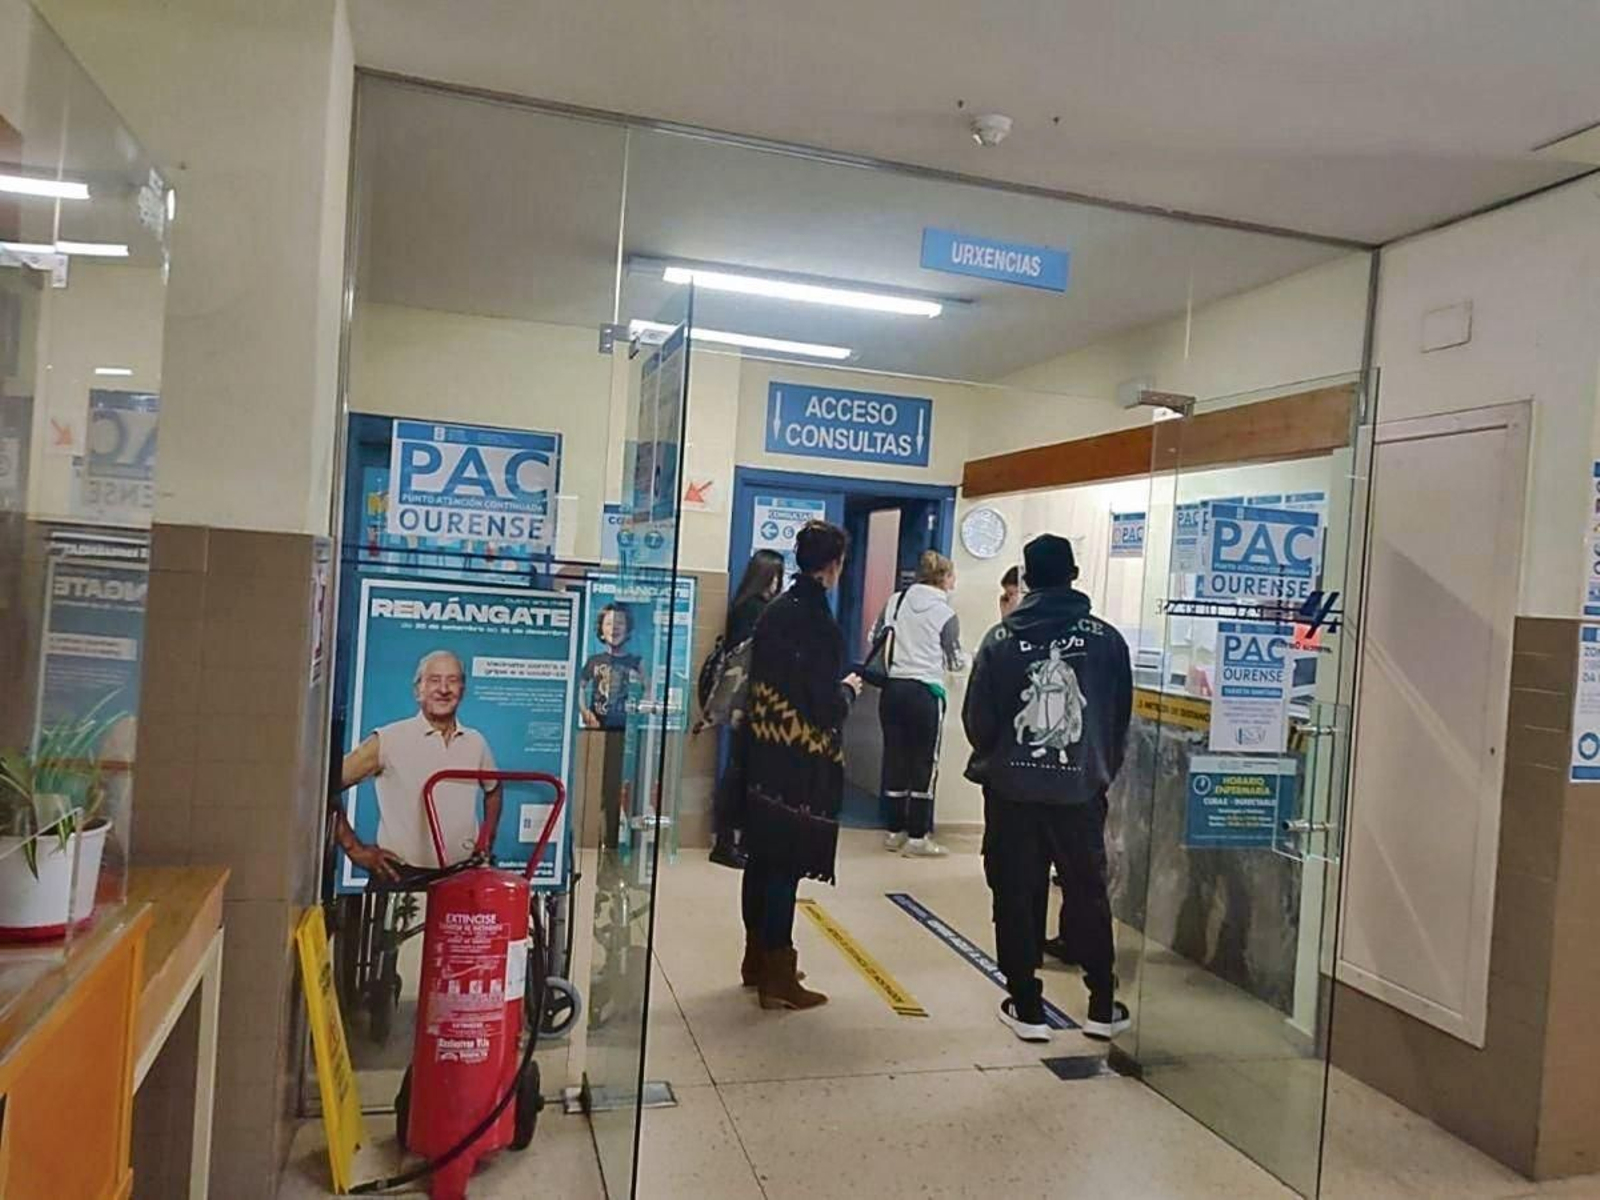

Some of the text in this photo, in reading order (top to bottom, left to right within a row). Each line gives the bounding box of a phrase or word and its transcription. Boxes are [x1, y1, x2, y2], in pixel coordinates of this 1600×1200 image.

[951, 241, 1042, 277] URXENCIAS
[805, 396, 898, 426] ACCESO
[785, 423, 912, 457] CONSULTAS
[400, 441, 549, 500] PAC
[399, 508, 545, 540] OURENSE
[1178, 512, 1199, 528] PAC
[1212, 520, 1315, 567] PAC
[1212, 574, 1310, 598] OURENSE
[371, 597, 570, 627] REMÁNGATE
[1224, 635, 1286, 665] PAC
[1223, 667, 1283, 683] OURENSE
